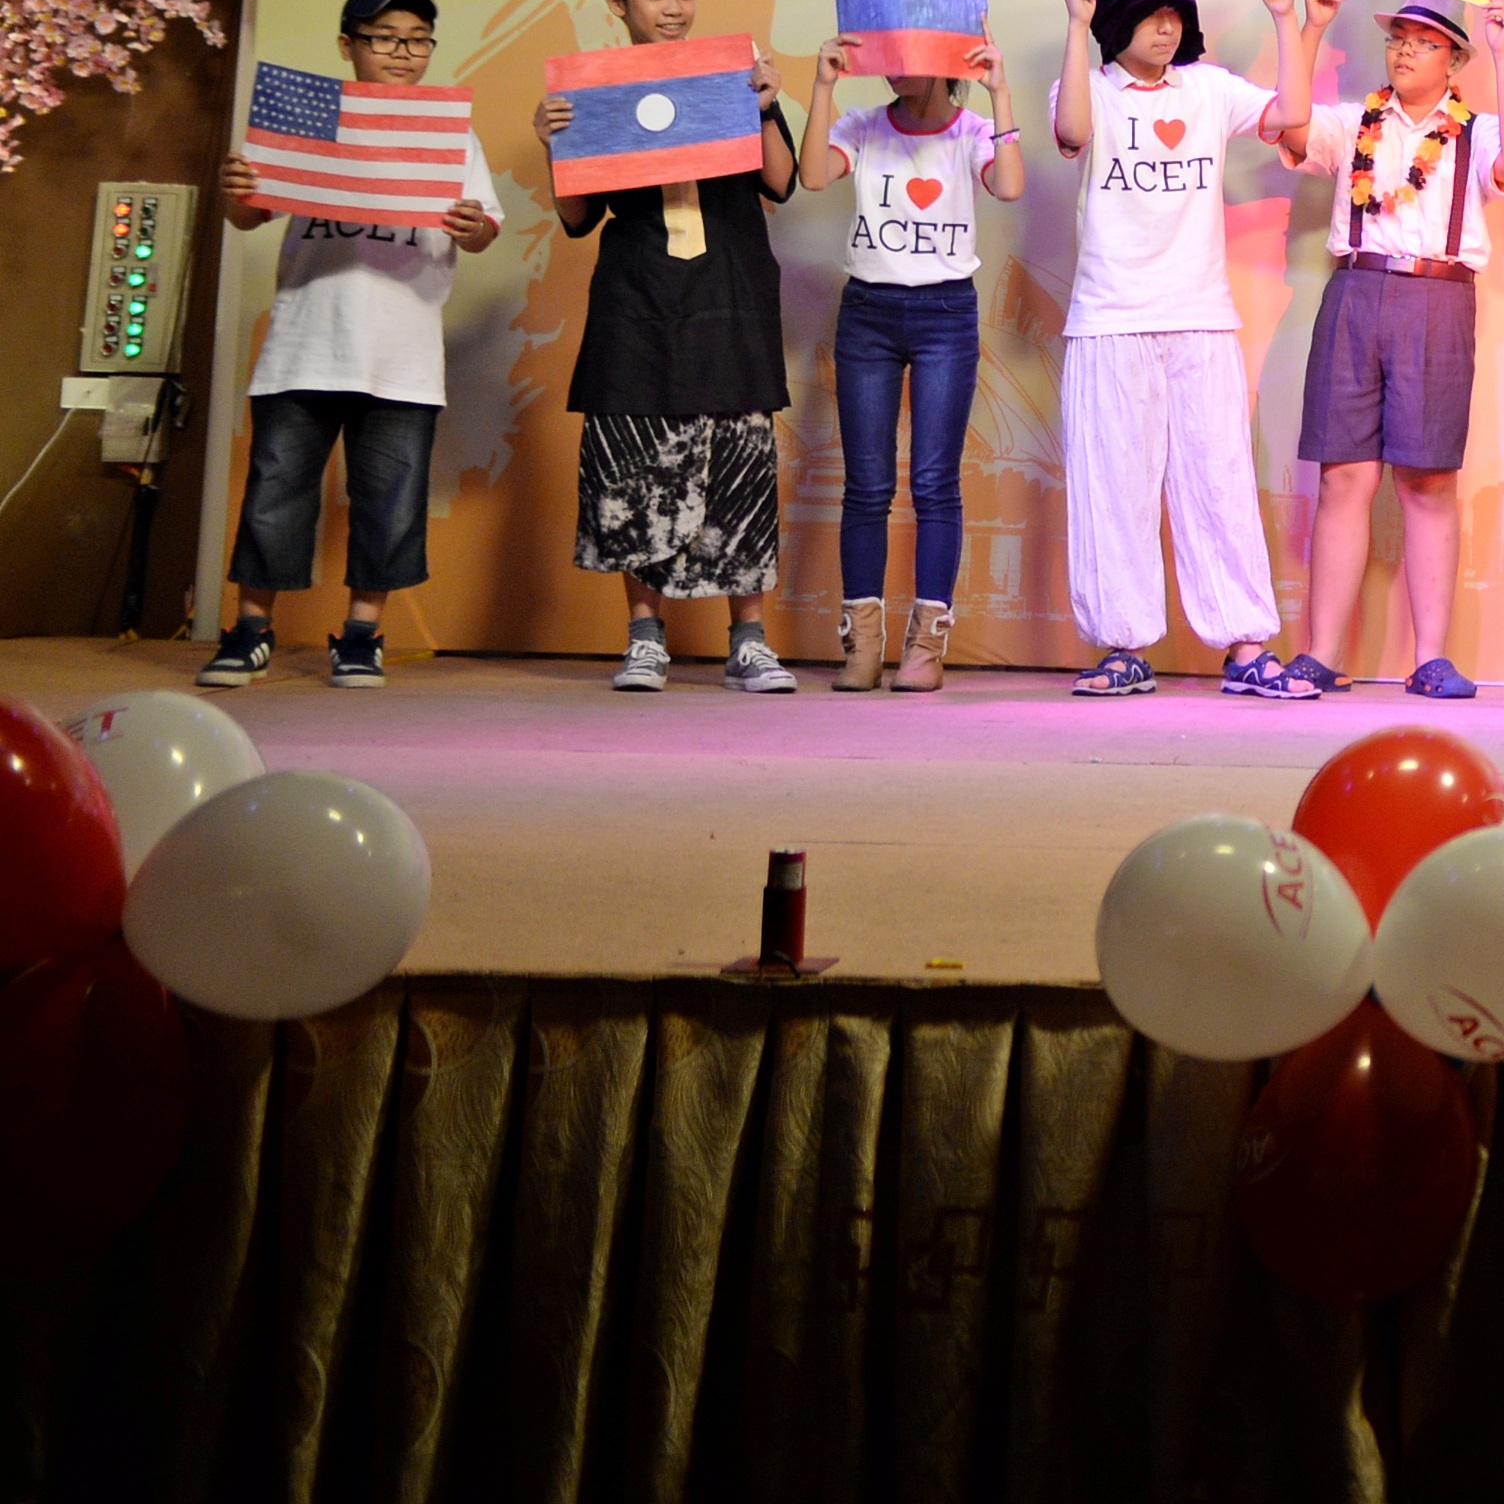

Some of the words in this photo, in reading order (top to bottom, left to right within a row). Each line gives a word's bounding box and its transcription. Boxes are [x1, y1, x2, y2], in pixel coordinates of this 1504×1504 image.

[1127, 116, 1139, 150] I
[879, 174, 895, 208] I
[1100, 157, 1214, 192] ACET
[851, 215, 969, 257] ACET
